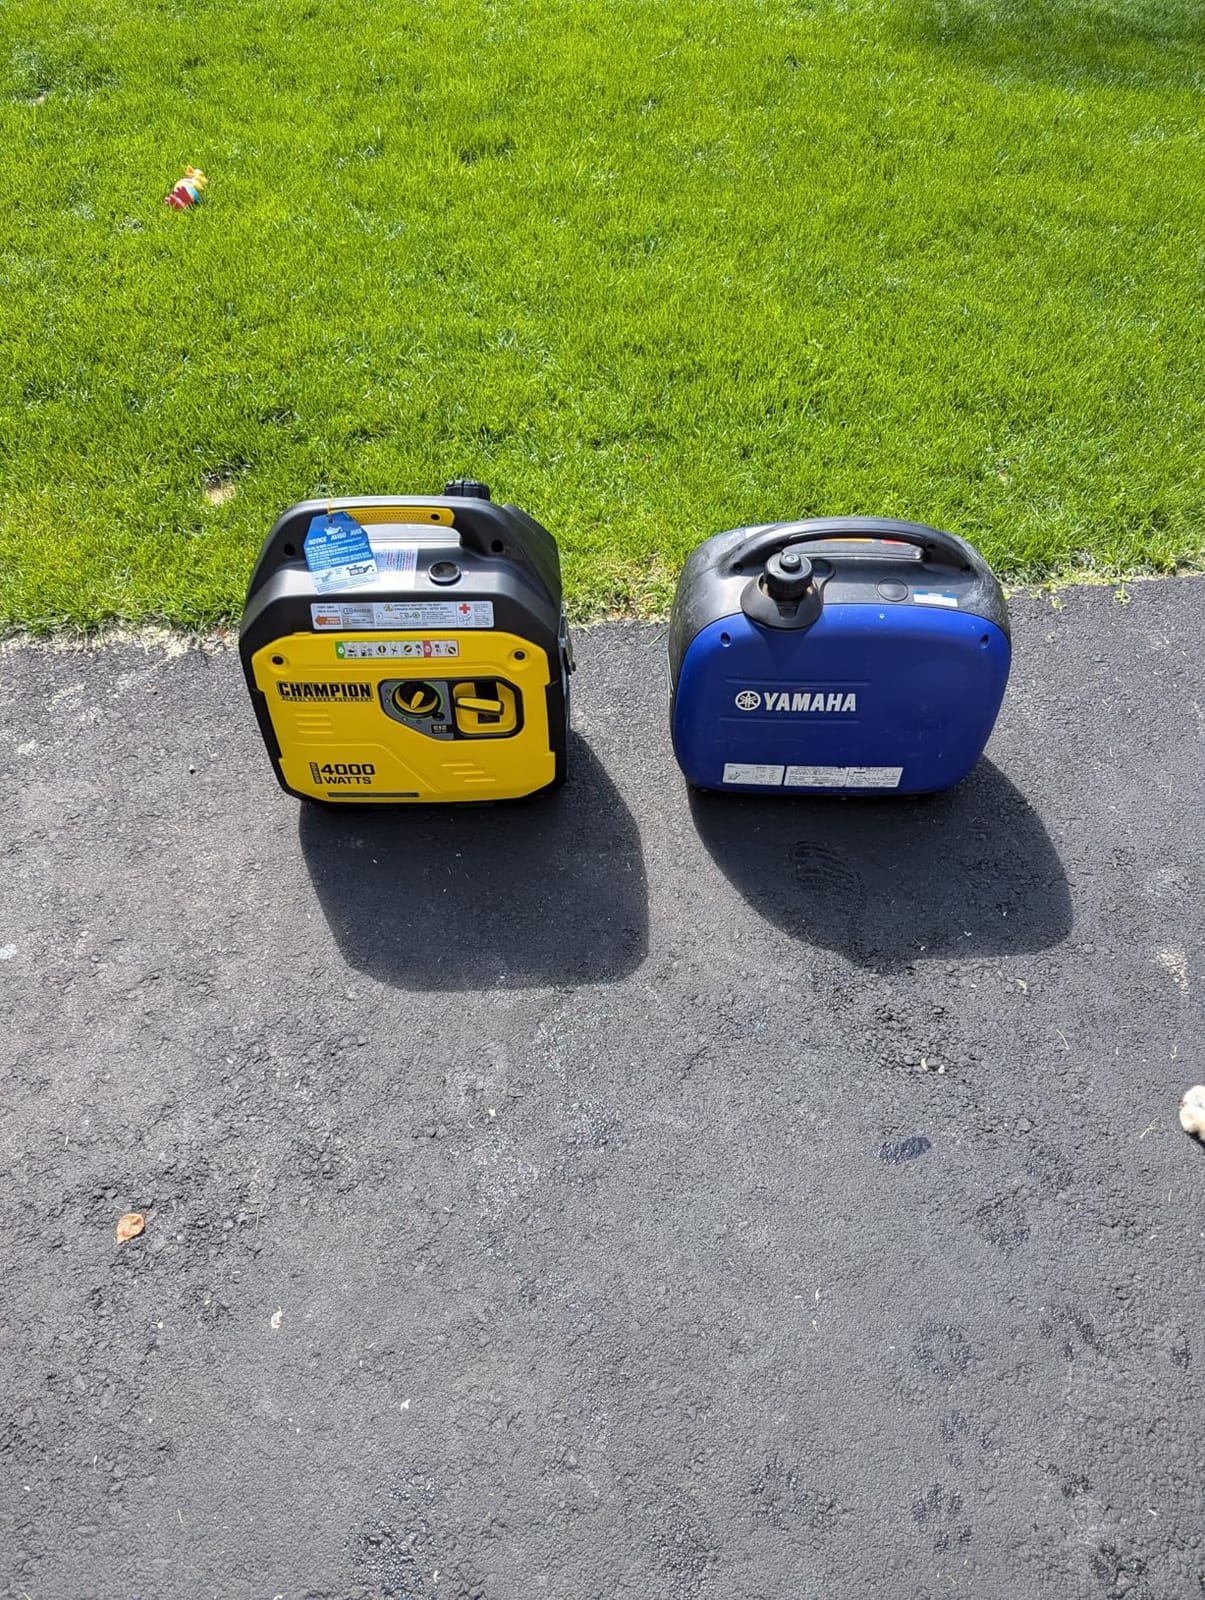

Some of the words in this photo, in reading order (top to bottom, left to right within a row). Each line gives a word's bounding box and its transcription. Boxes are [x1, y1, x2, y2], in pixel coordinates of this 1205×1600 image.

[278, 682, 371, 697] CHAMPION
[763, 692, 857, 712] YAMAHA
[321, 764, 375, 775] 4000
[323, 776, 372, 784] WATTS
